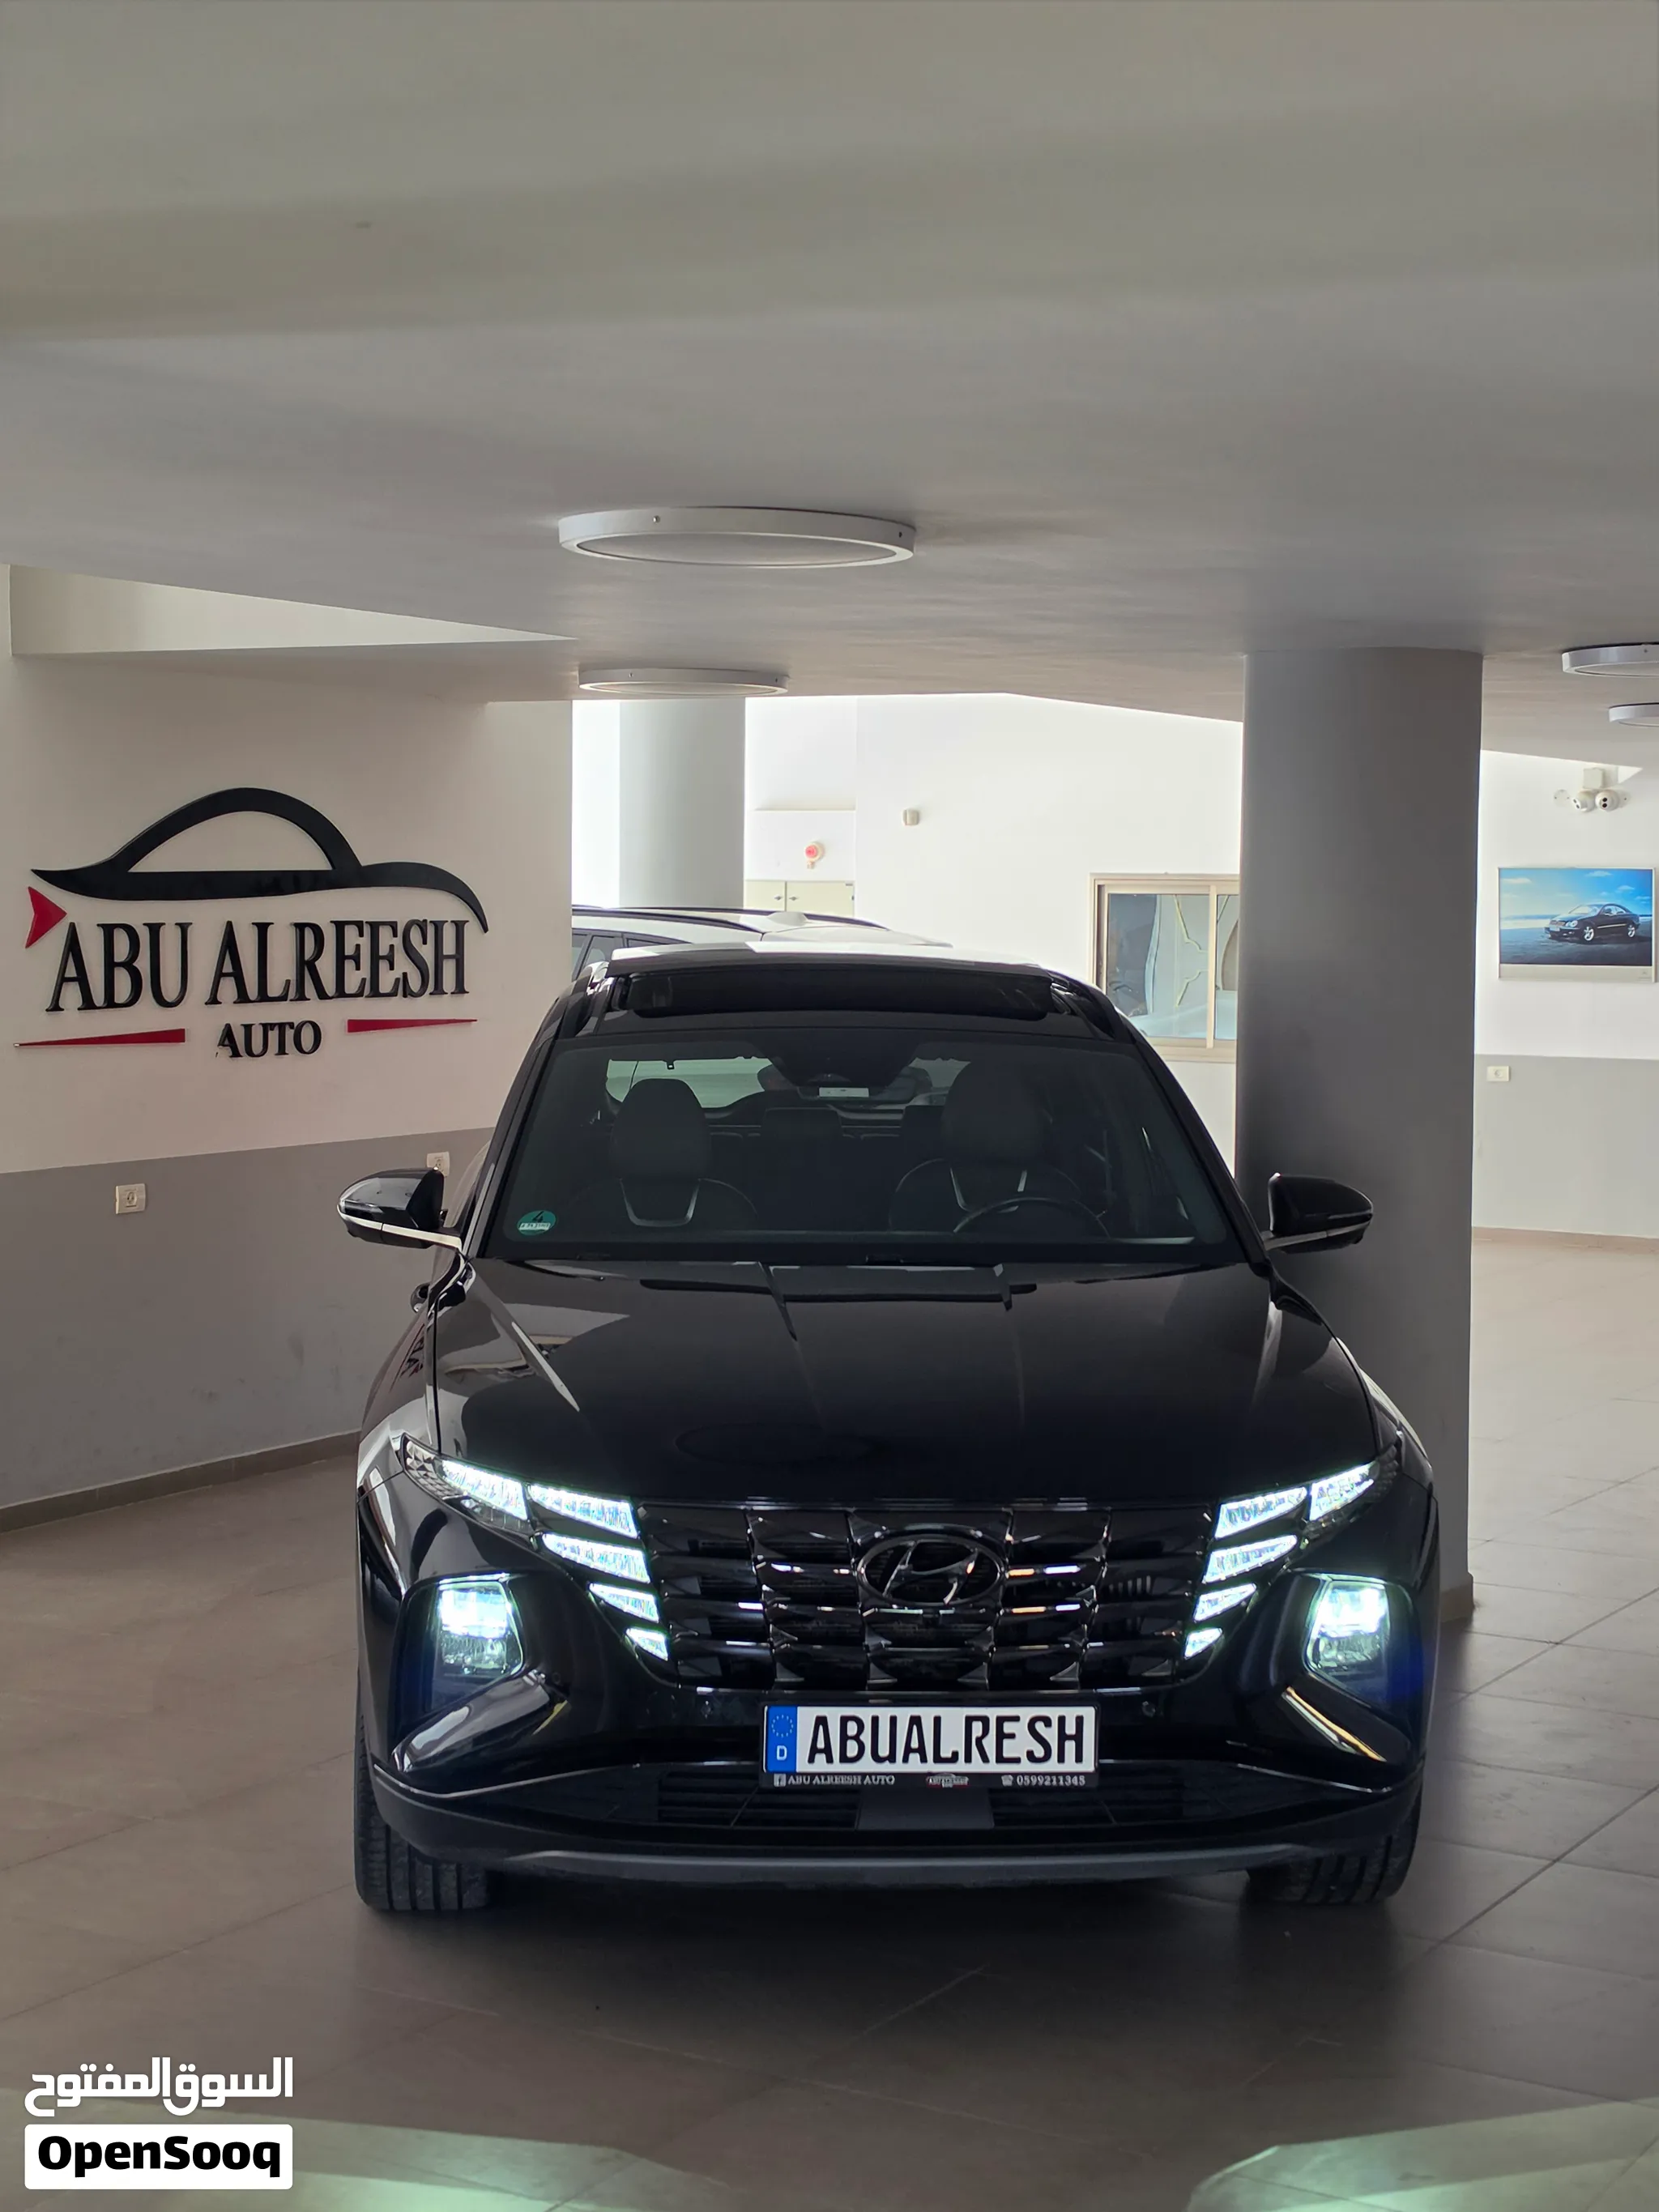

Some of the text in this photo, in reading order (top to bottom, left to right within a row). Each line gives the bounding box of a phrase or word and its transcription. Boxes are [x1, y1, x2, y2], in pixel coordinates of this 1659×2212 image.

[45, 918, 470, 1012] ABU ALREESH
[216, 1020, 322, 1059] AUTO
[776, 1745, 787, 1761] D
[807, 1715, 1084, 1764] ABUALRESH
[787, 1775, 895, 1785] ABU ALREESH AUTO
